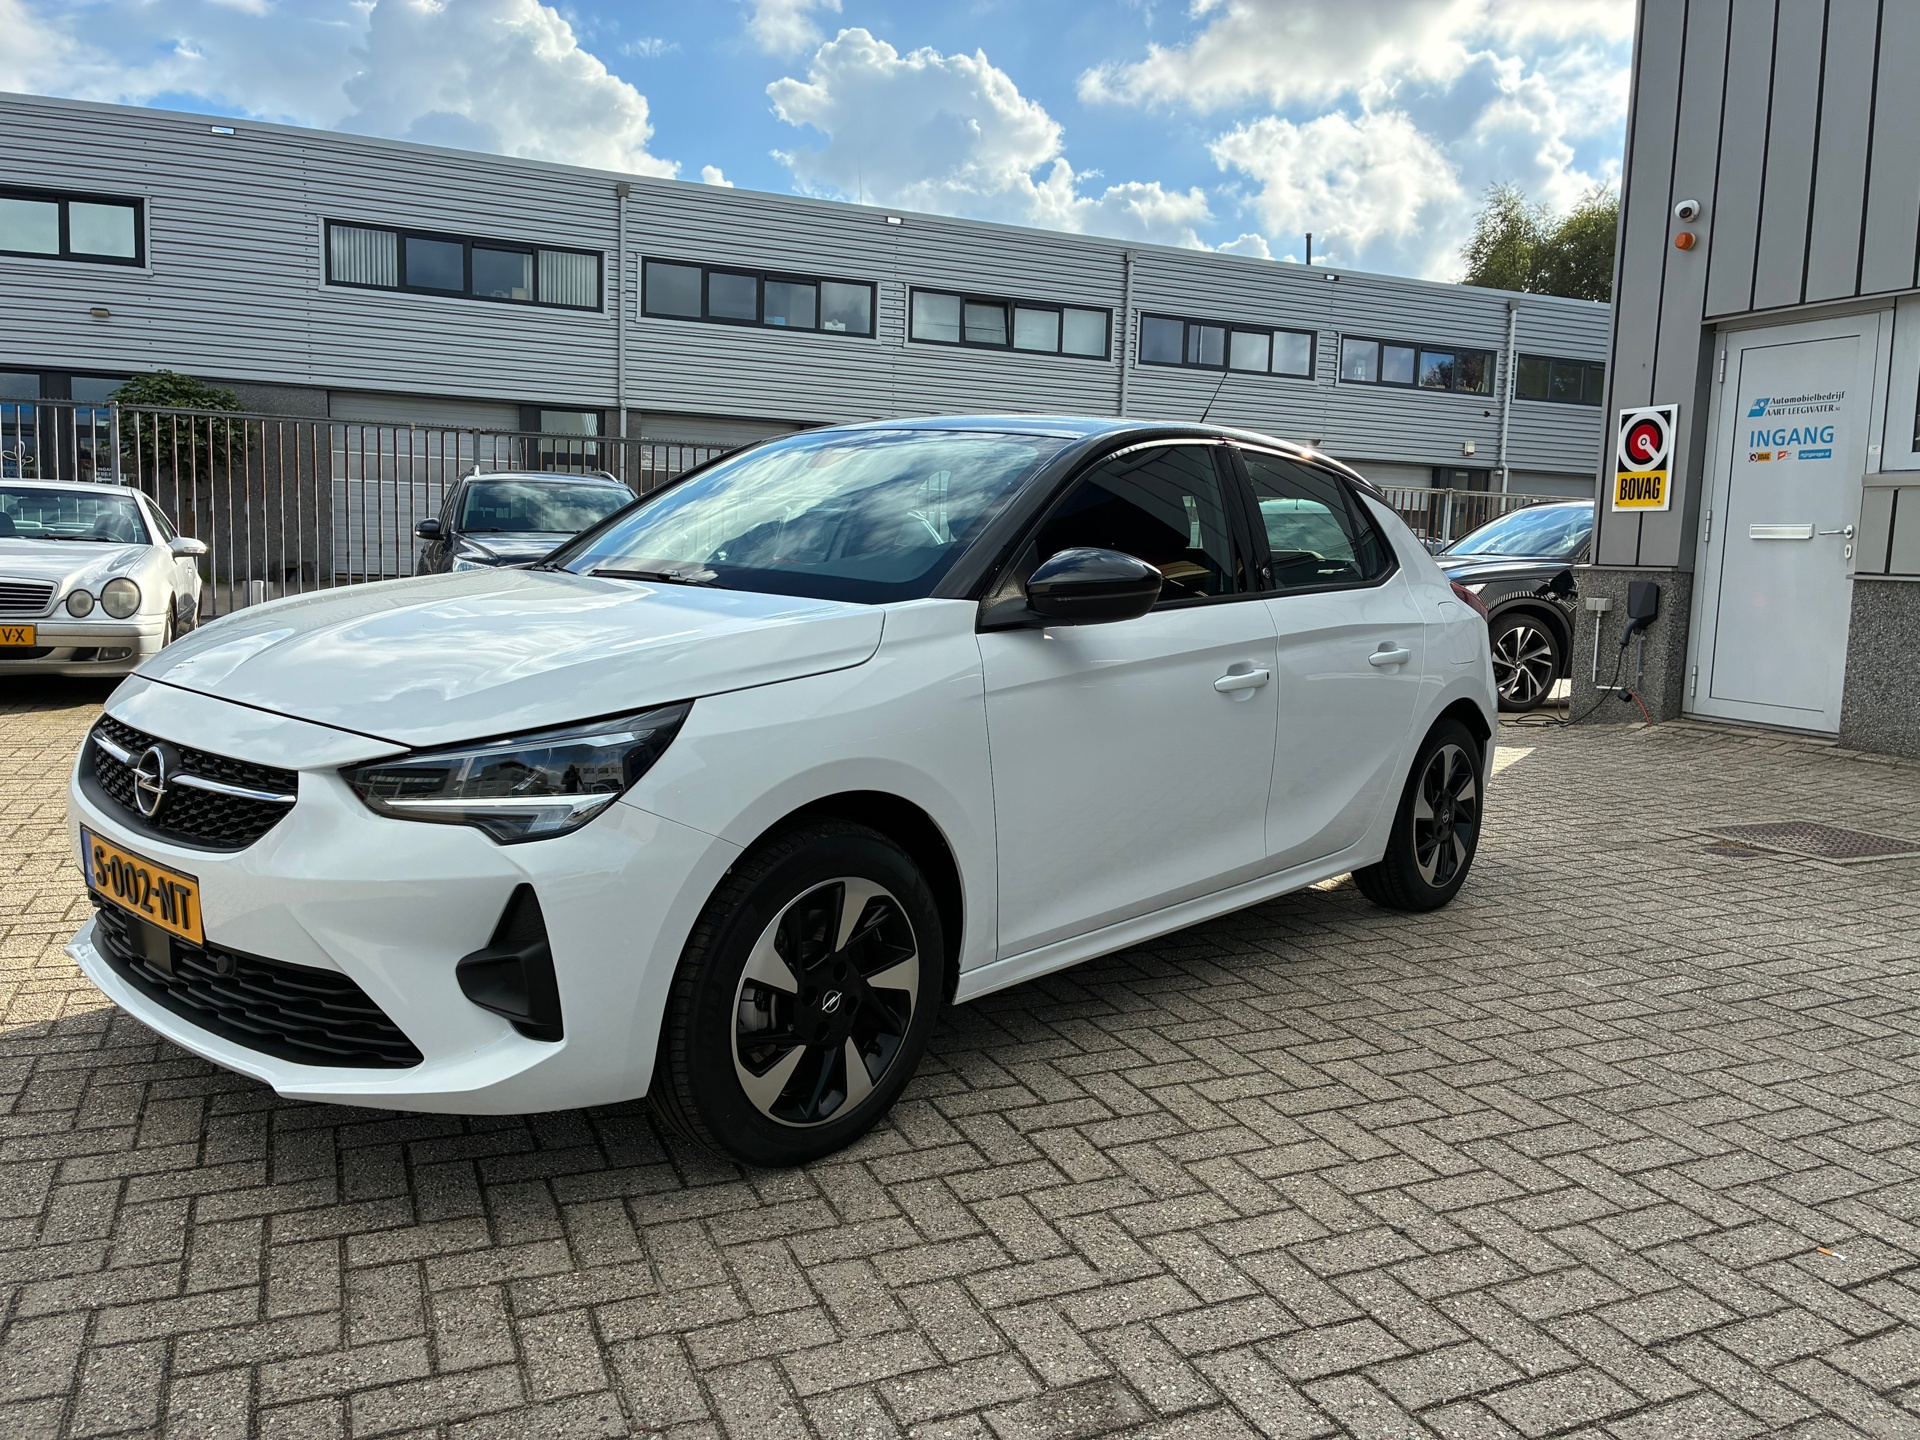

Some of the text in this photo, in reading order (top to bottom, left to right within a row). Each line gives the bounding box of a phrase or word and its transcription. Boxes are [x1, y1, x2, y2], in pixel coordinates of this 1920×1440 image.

[1770, 391, 1845, 404] Automobielbedrijf
[1765, 407, 1786, 416] AART
[1750, 425, 1834, 448] INGANG
[1619, 476, 1661, 501] BOVAG
[94, 844, 191, 930] S-002-NT
